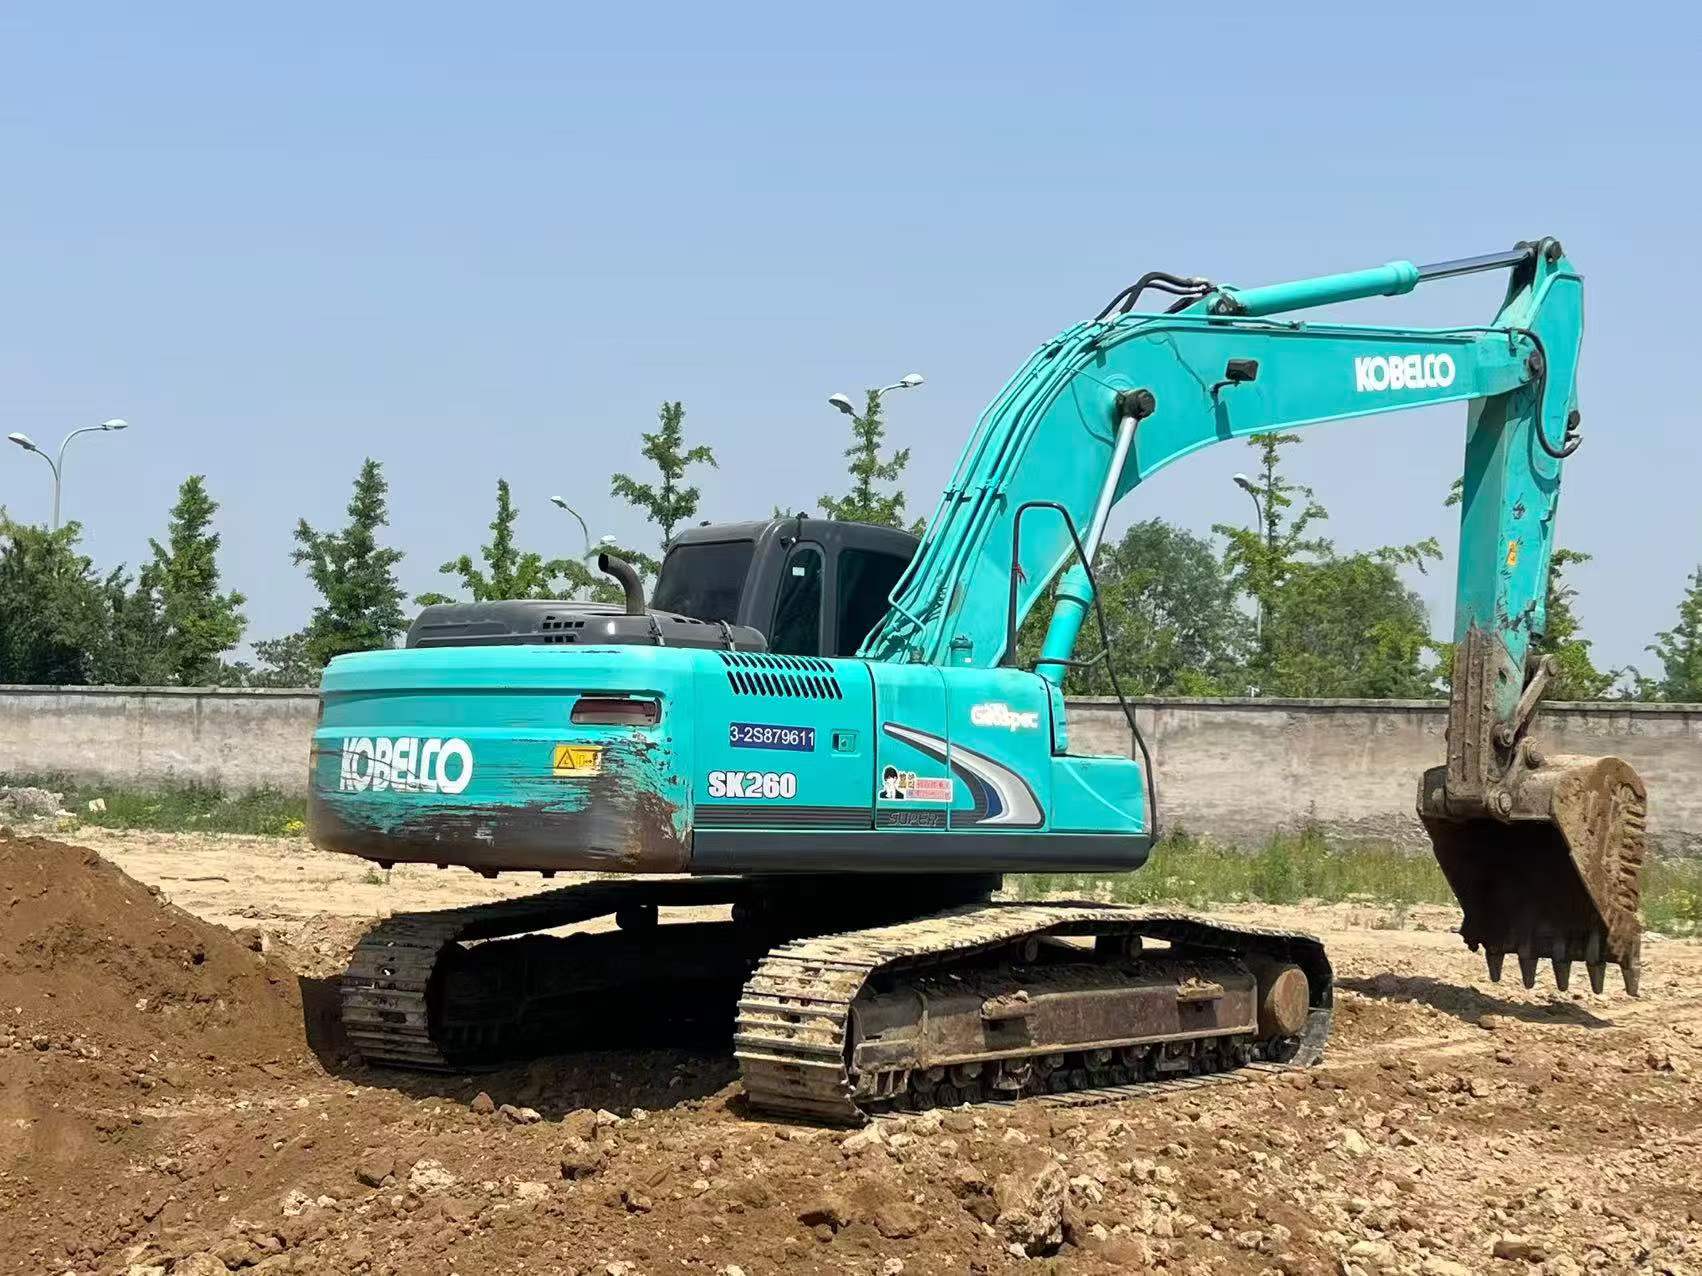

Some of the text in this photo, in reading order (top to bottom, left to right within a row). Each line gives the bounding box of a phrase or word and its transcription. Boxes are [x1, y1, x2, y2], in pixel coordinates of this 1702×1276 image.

[1355, 353, 1456, 392] KOBELCO
[730, 726, 814, 747] 3-2S879611
[340, 737, 473, 794] KOBELCO
[707, 770, 797, 799] SK260
